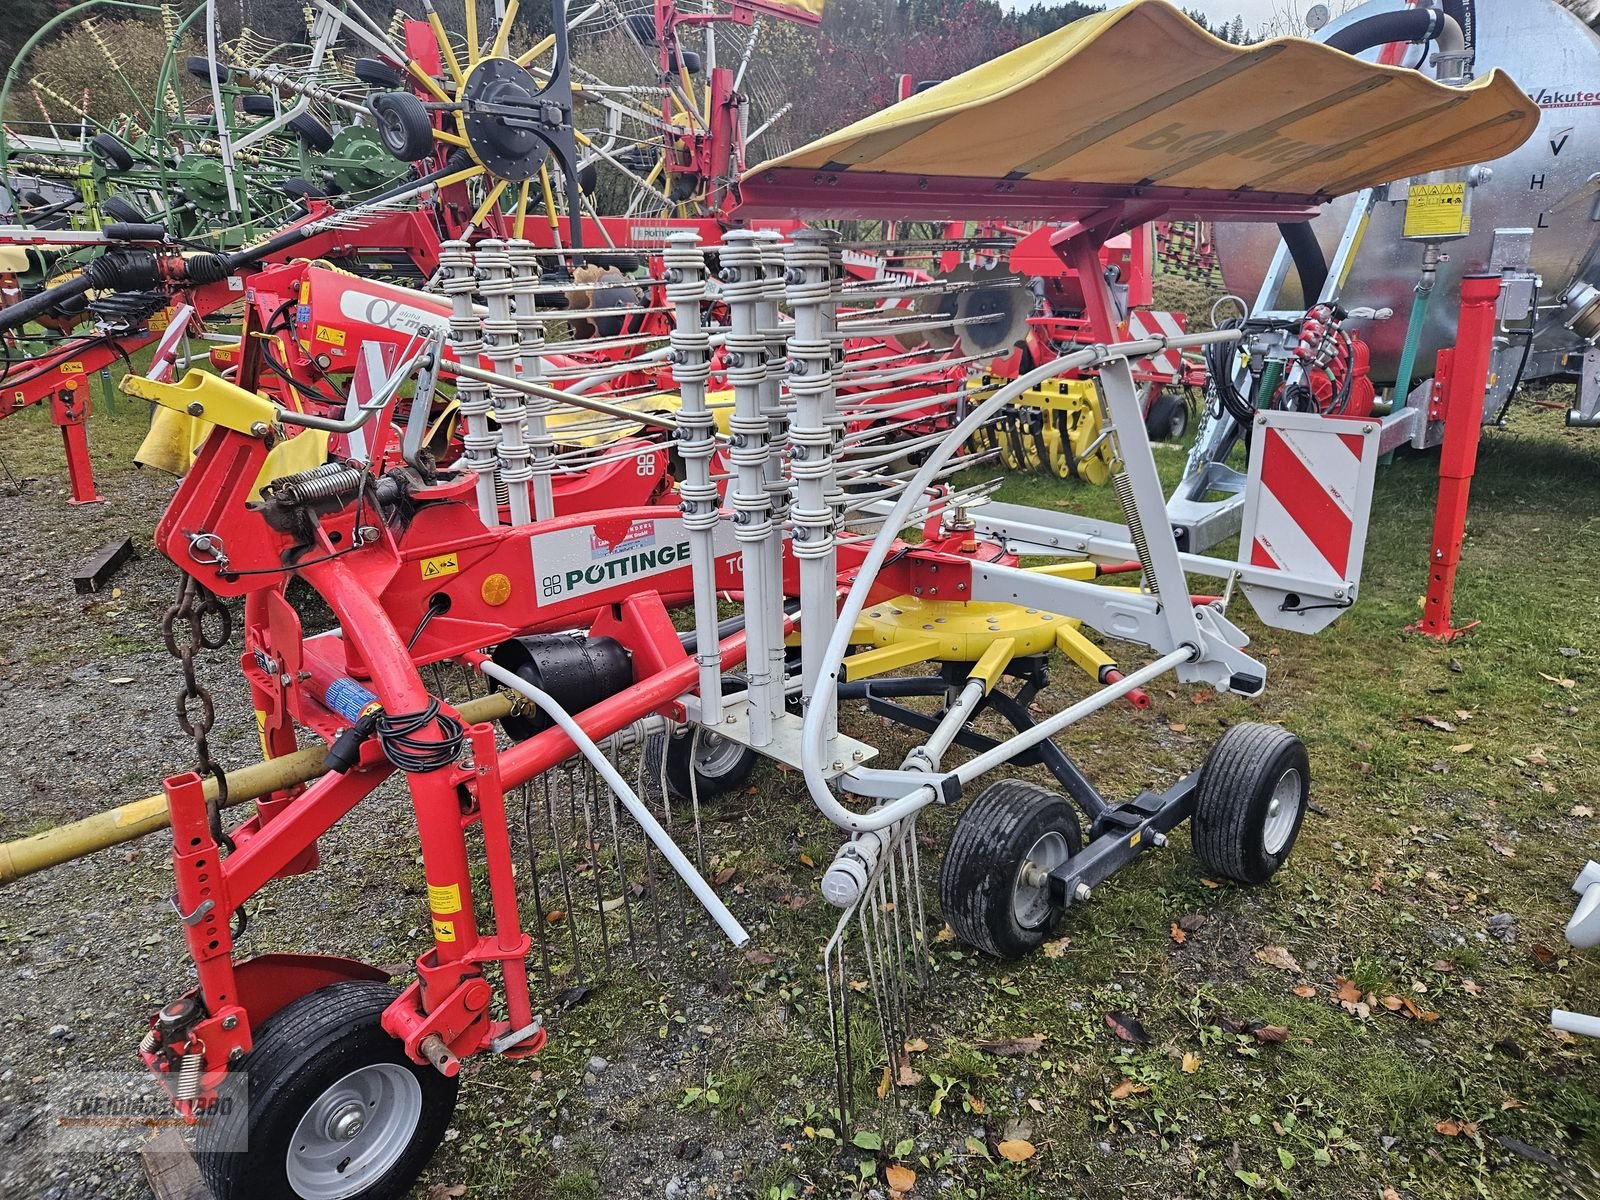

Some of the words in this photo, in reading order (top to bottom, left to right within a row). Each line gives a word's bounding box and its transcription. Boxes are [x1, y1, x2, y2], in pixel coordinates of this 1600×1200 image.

[1530, 174, 1545, 190] H
[1537, 213, 1549, 229] L
[399, 310, 421, 321] alpha
[566, 541, 691, 590] PÖTTINGE
